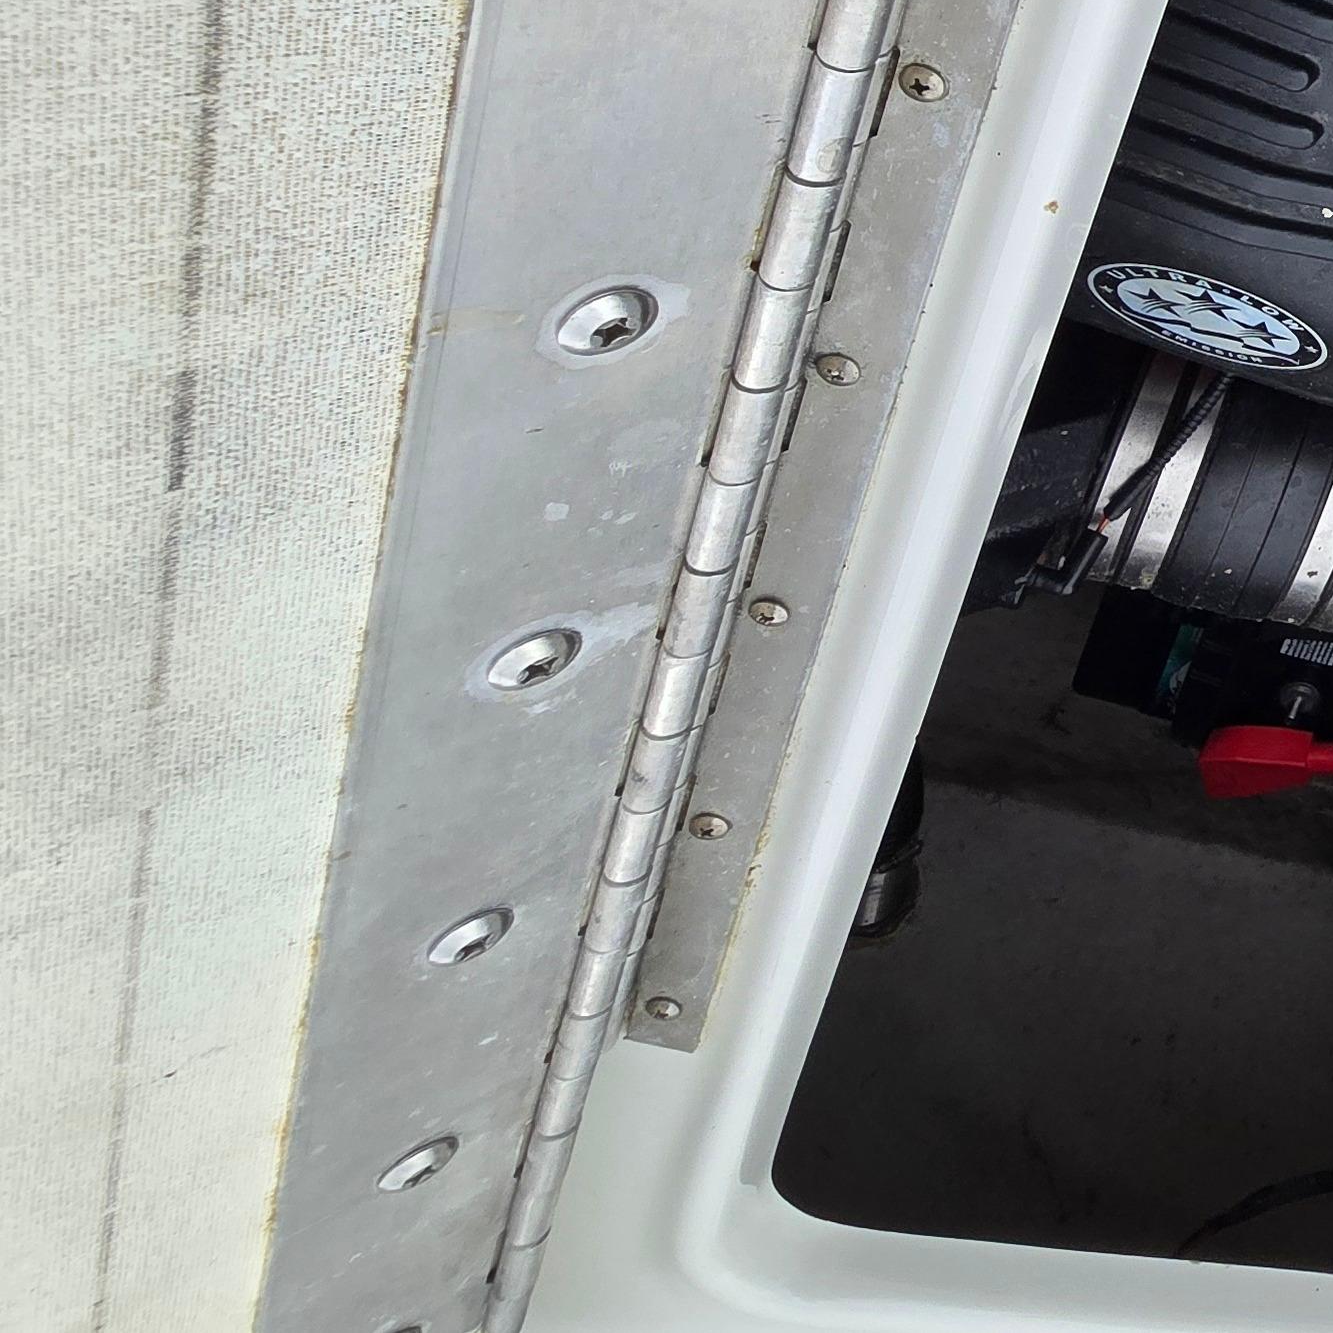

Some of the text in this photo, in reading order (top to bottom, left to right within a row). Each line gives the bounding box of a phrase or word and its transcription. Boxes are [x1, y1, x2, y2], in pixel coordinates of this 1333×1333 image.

[1106, 266, 1305, 333] ULTRA LOW
[1160, 328, 1263, 364] EMISSION
